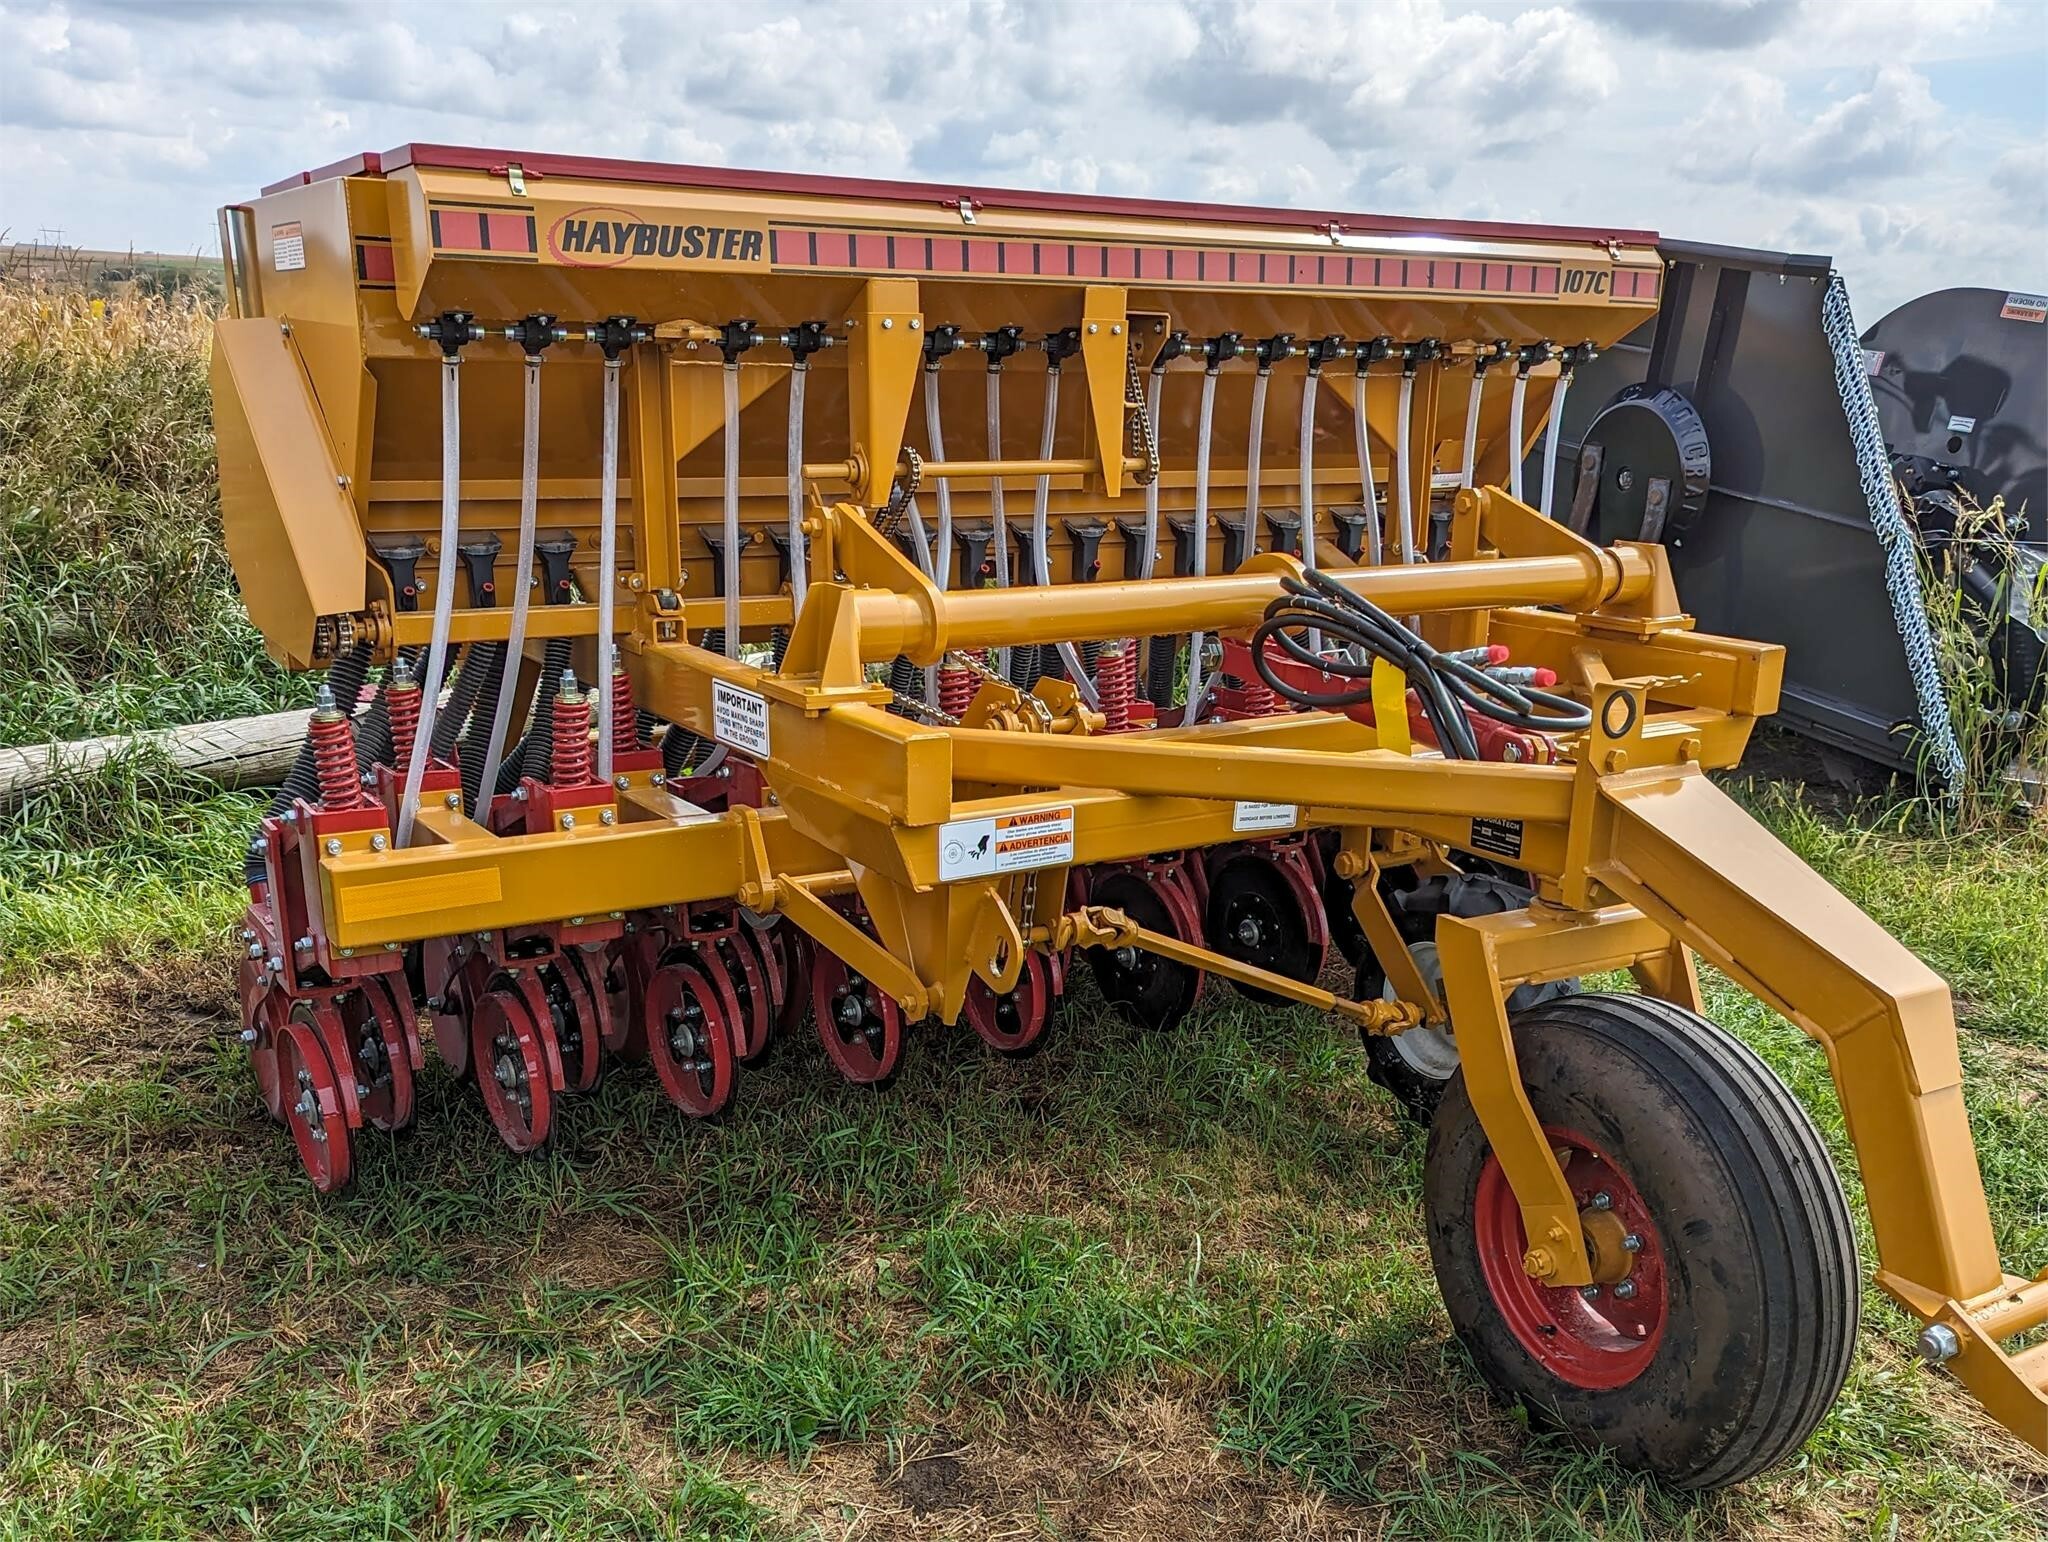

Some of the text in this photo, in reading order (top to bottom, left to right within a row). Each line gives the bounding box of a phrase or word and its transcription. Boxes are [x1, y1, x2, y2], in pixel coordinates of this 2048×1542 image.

[561, 219, 764, 262] HAYBUSTER
[1562, 269, 1609, 295] 107C
[2008, 296, 2035, 307] RIDERS
[717, 689, 763, 717] IMPORTANT
[731, 710, 748, 724] MAKING
[749, 716, 765, 729] SHARP
[723, 727, 759, 748] IN THE GROUND
[732, 720, 743, 732] WITH
[744, 724, 766, 741] OPENERS
[1019, 811, 1061, 825] WARNING
[1009, 833, 1069, 851] ADVERTENCIA
